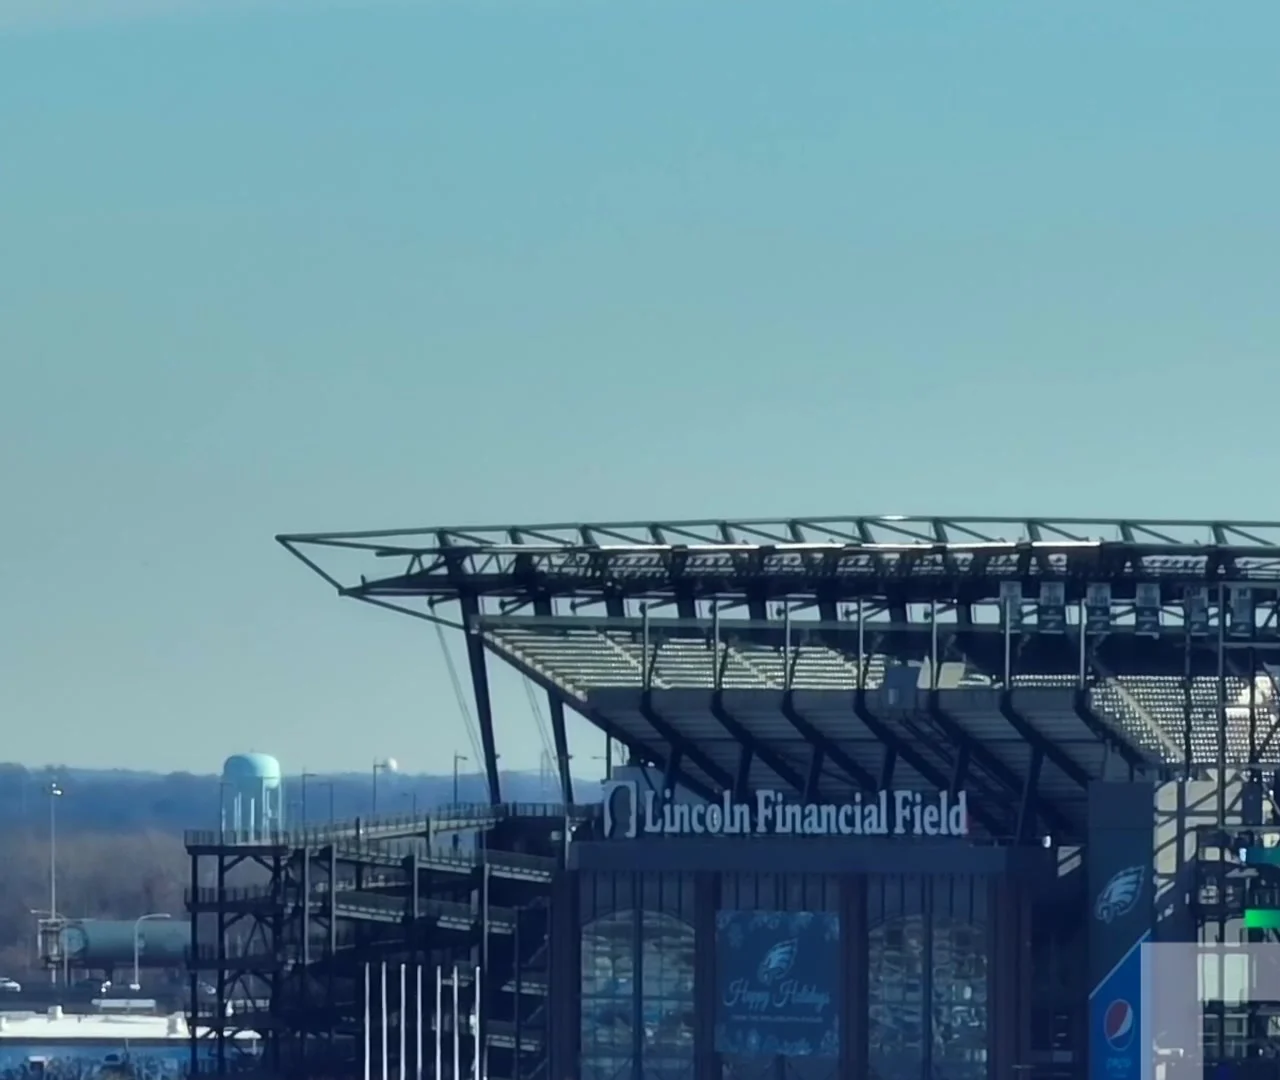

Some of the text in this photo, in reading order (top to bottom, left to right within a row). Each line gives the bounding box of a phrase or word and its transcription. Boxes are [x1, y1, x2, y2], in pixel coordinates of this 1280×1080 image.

[644, 789, 969, 836] Lincoln Financial Field
[723, 977, 830, 1013] Happy Holidays
